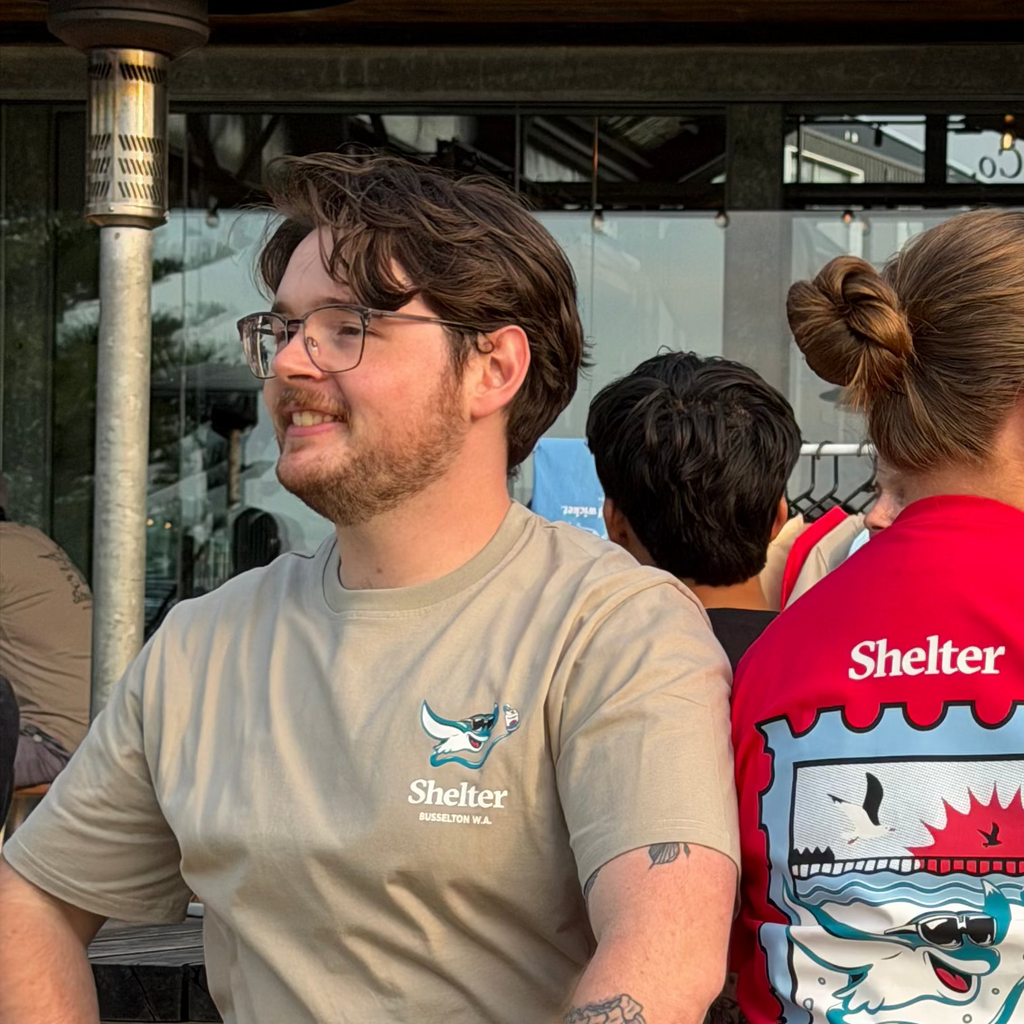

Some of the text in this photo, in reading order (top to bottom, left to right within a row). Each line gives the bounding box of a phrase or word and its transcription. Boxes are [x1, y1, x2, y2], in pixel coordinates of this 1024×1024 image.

[848, 634, 1006, 681] Shelter
[407, 778, 508, 809] Shelter
[418, 811, 493, 825] BUSSELTON W.A.
